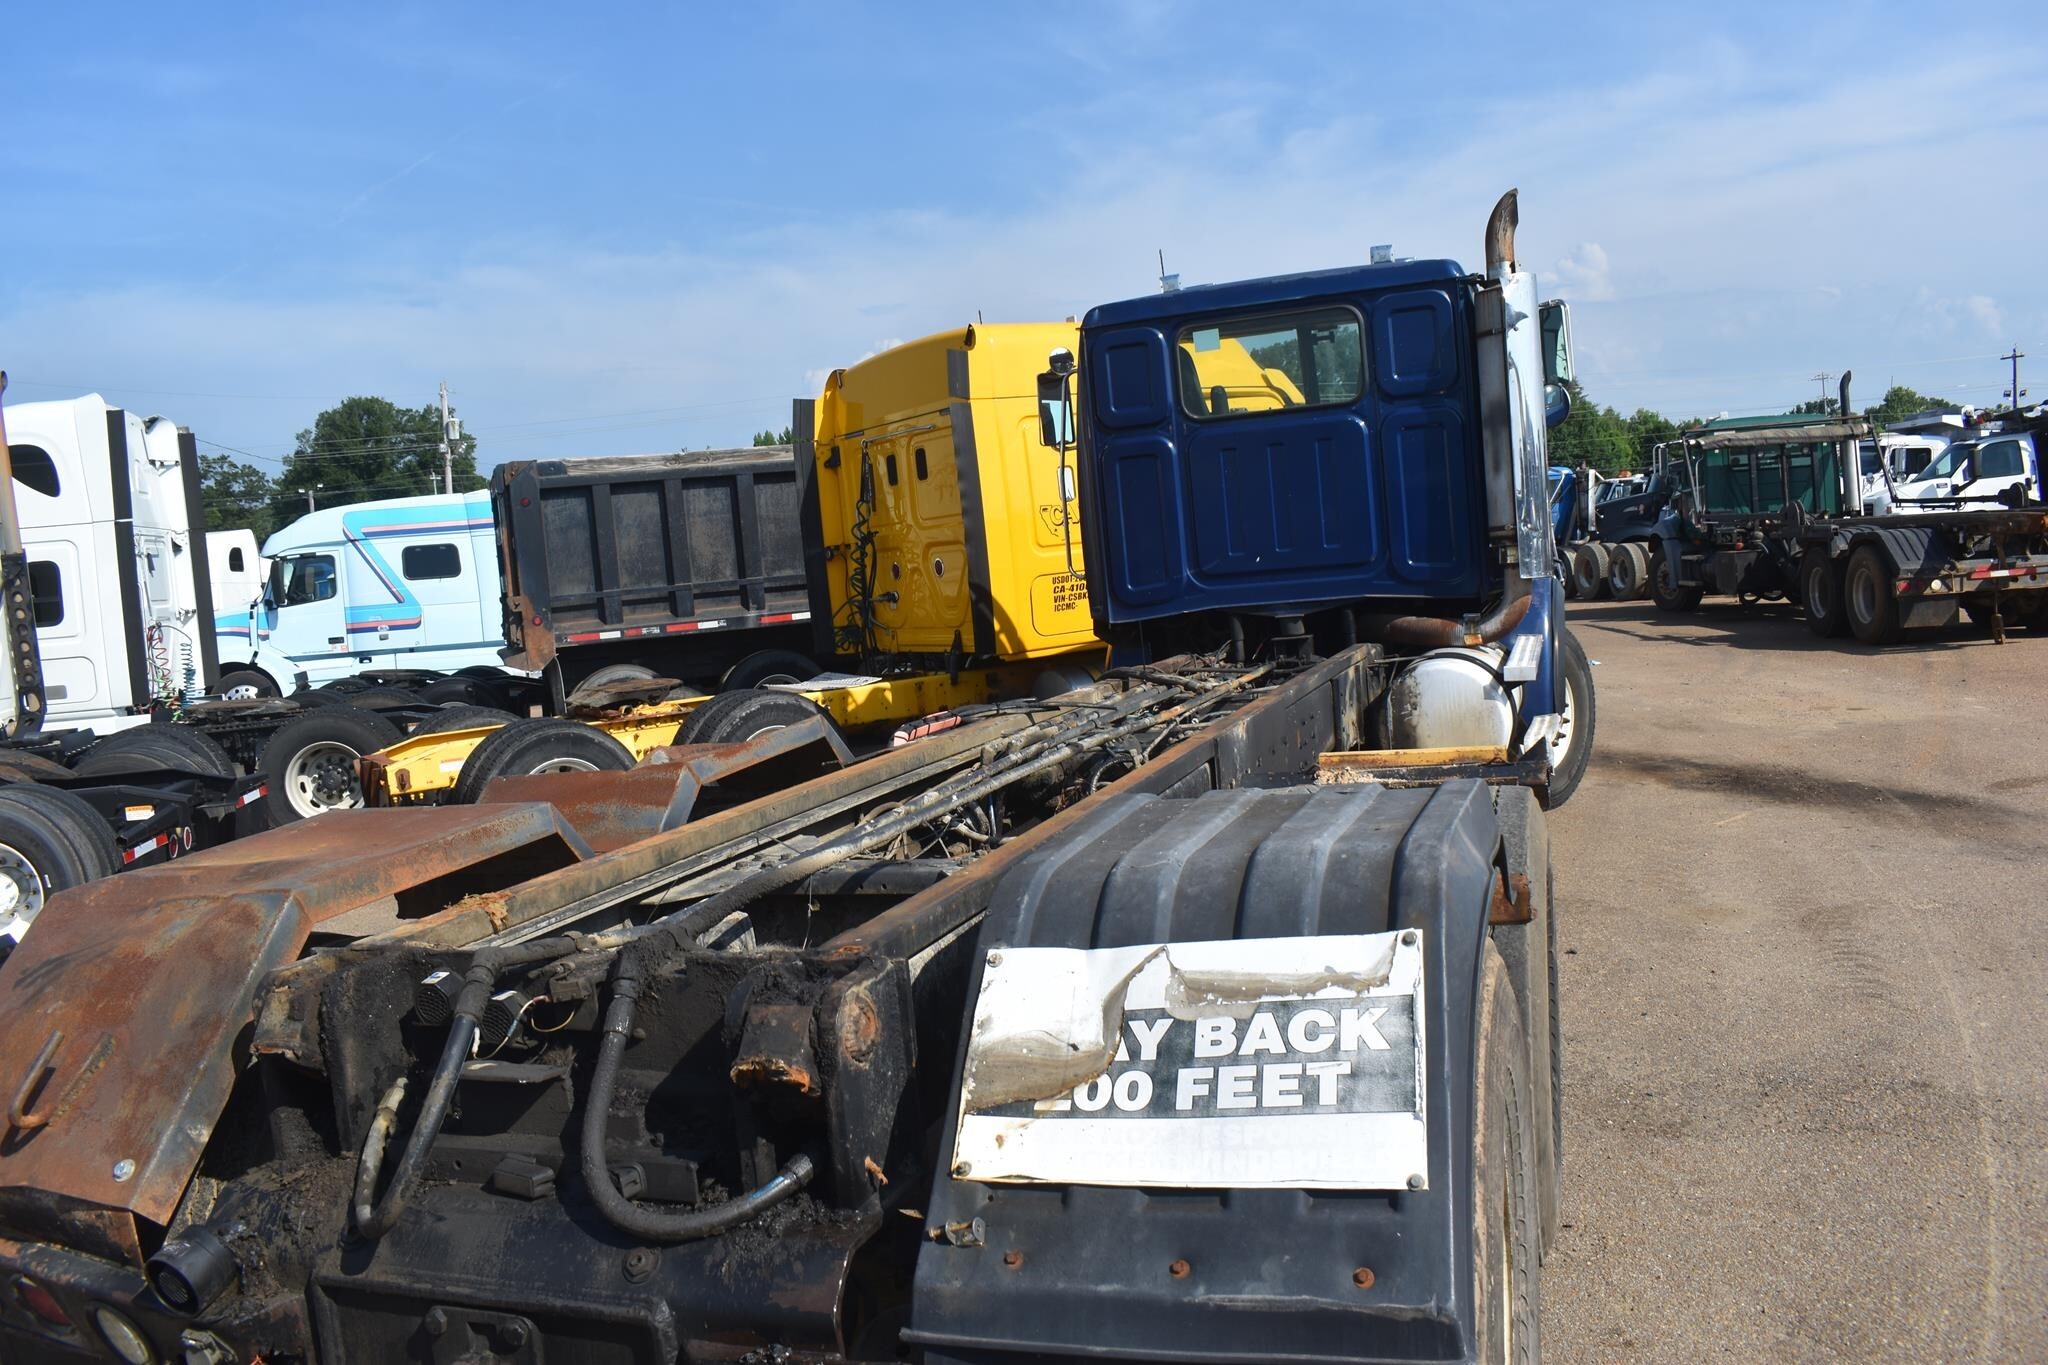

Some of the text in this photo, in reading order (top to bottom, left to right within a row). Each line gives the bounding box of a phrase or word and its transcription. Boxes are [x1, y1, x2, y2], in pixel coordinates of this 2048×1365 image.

[1054, 592, 1088, 603] VIN-CSBK
[1195, 1007, 1391, 1057] BACK
[1034, 1061, 1352, 1111] 00 FEET
